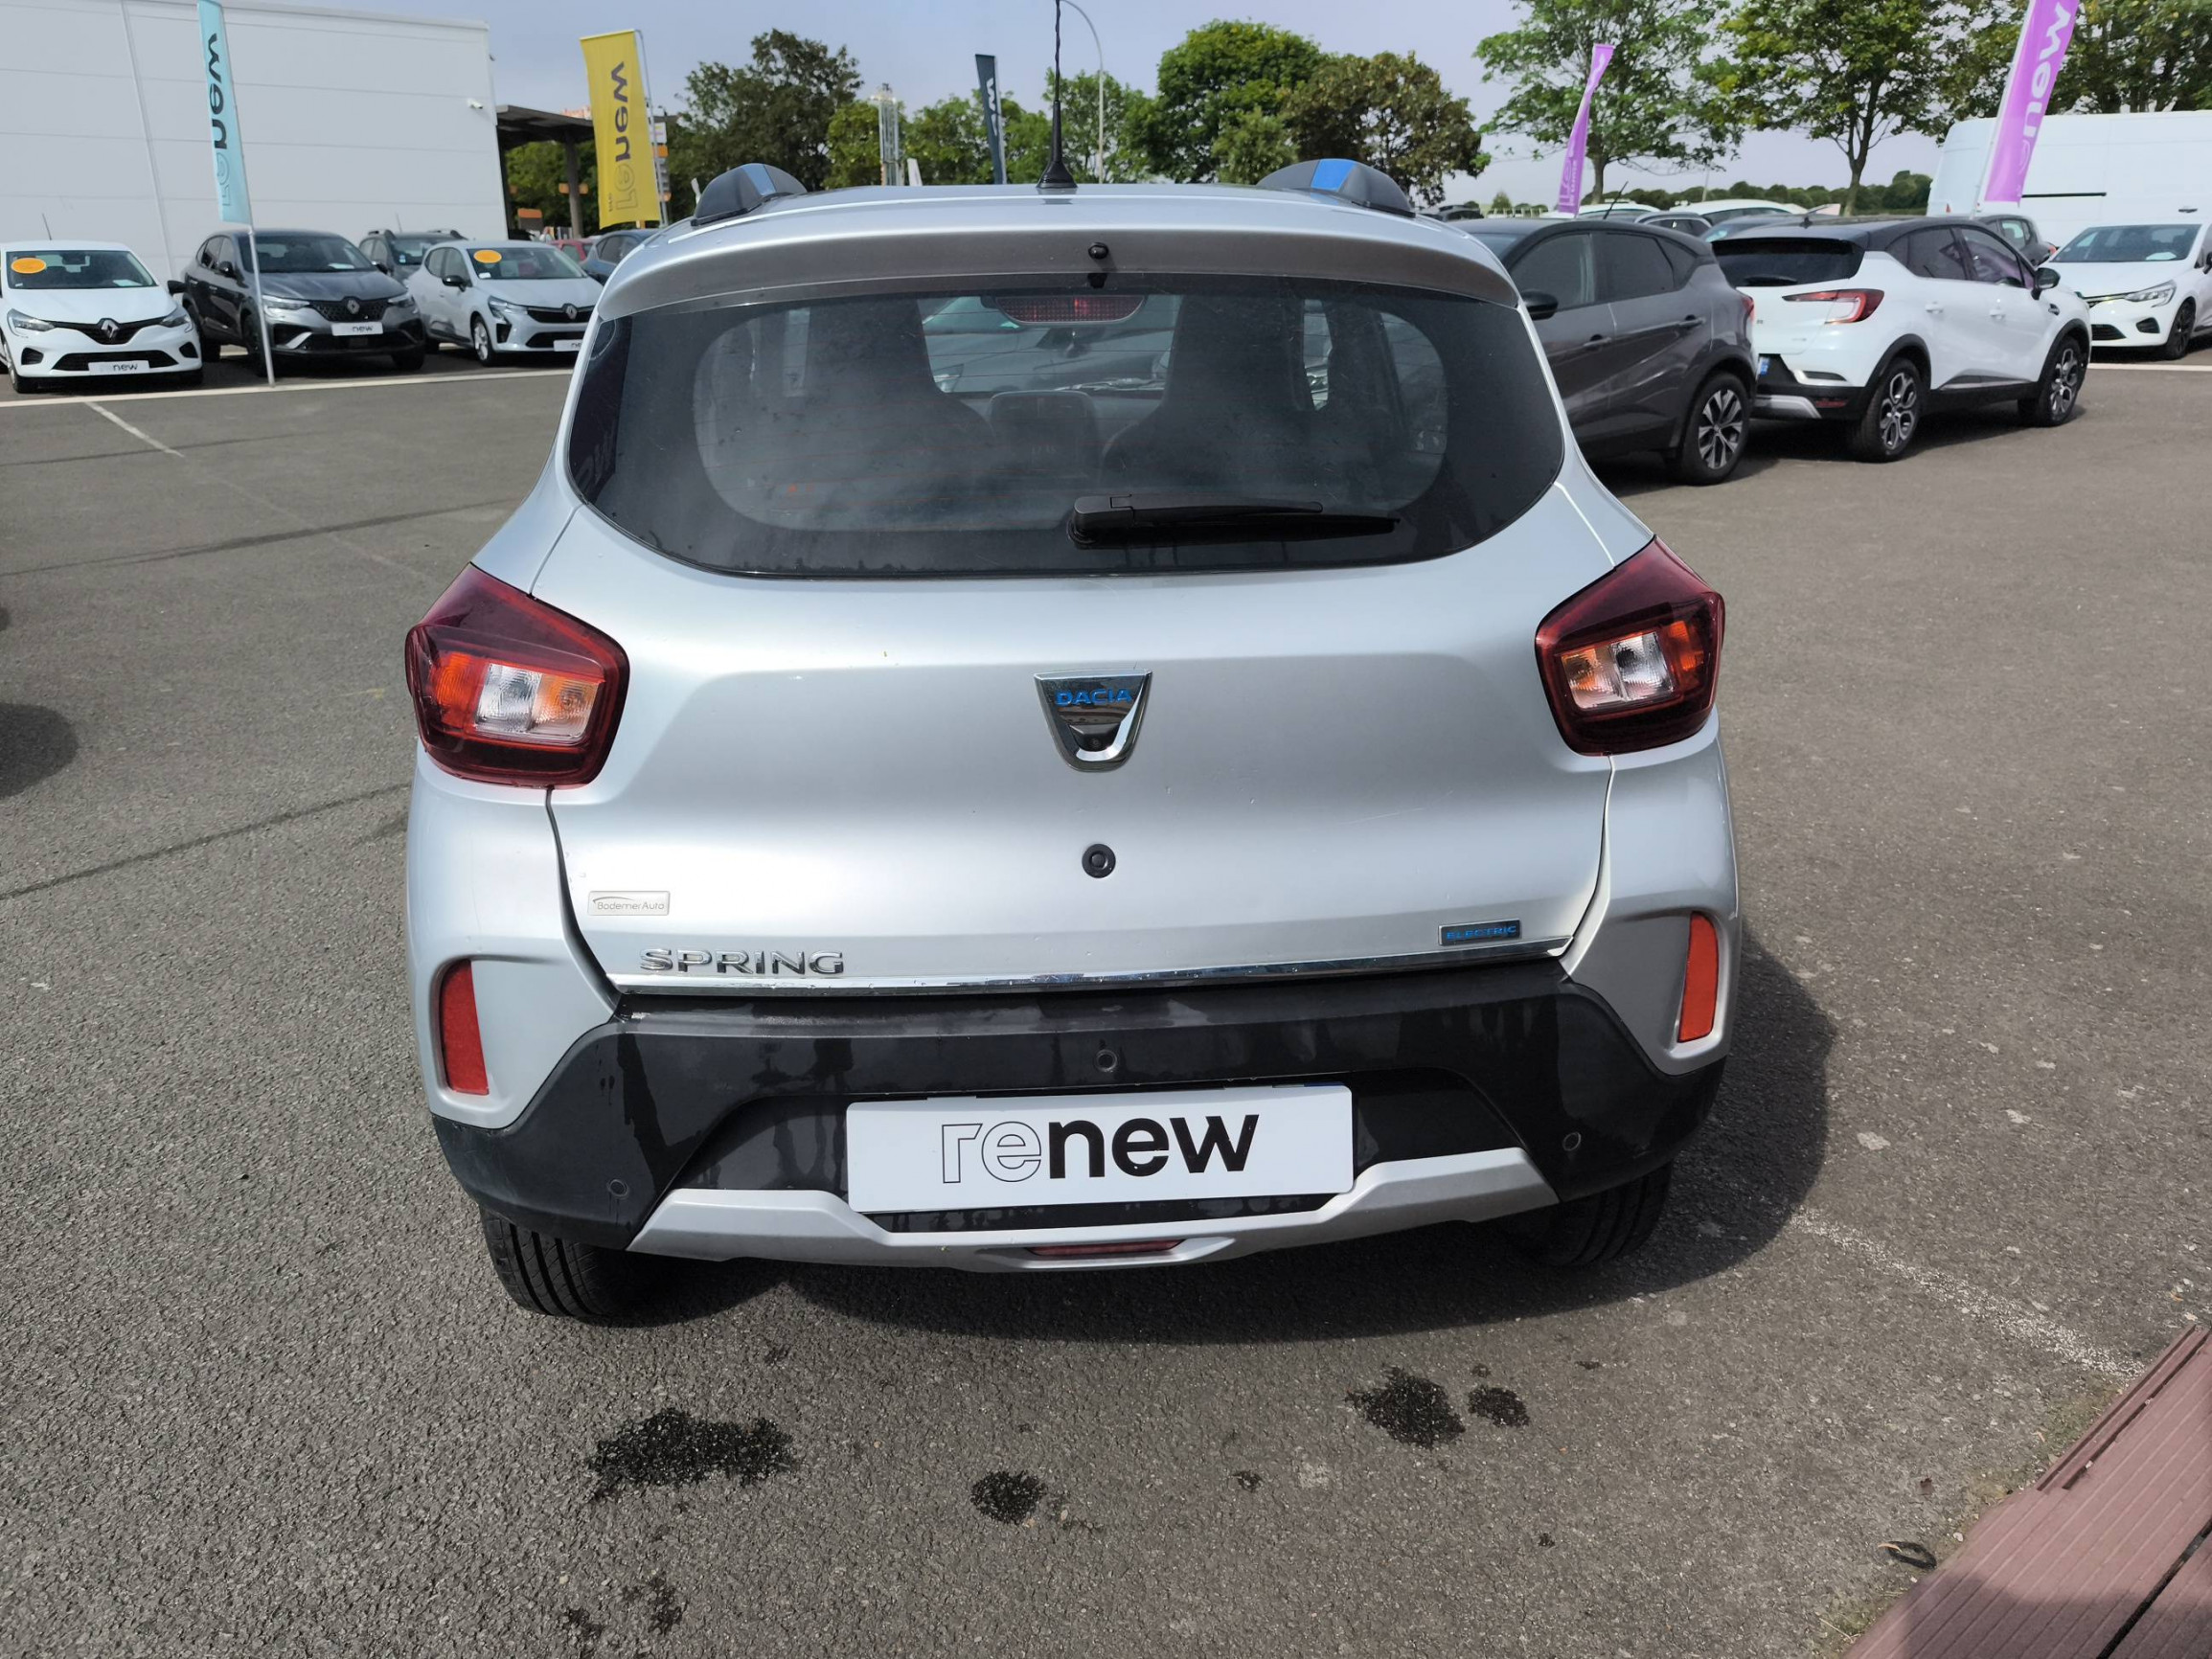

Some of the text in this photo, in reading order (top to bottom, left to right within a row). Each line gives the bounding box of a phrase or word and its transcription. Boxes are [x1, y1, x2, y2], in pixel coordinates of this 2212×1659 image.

[1055, 688, 1133, 706] DACIA
[1447, 925, 1517, 941] ELECTRIC
[640, 948, 844, 975] SPRING
[942, 1114, 1260, 1184] renew
